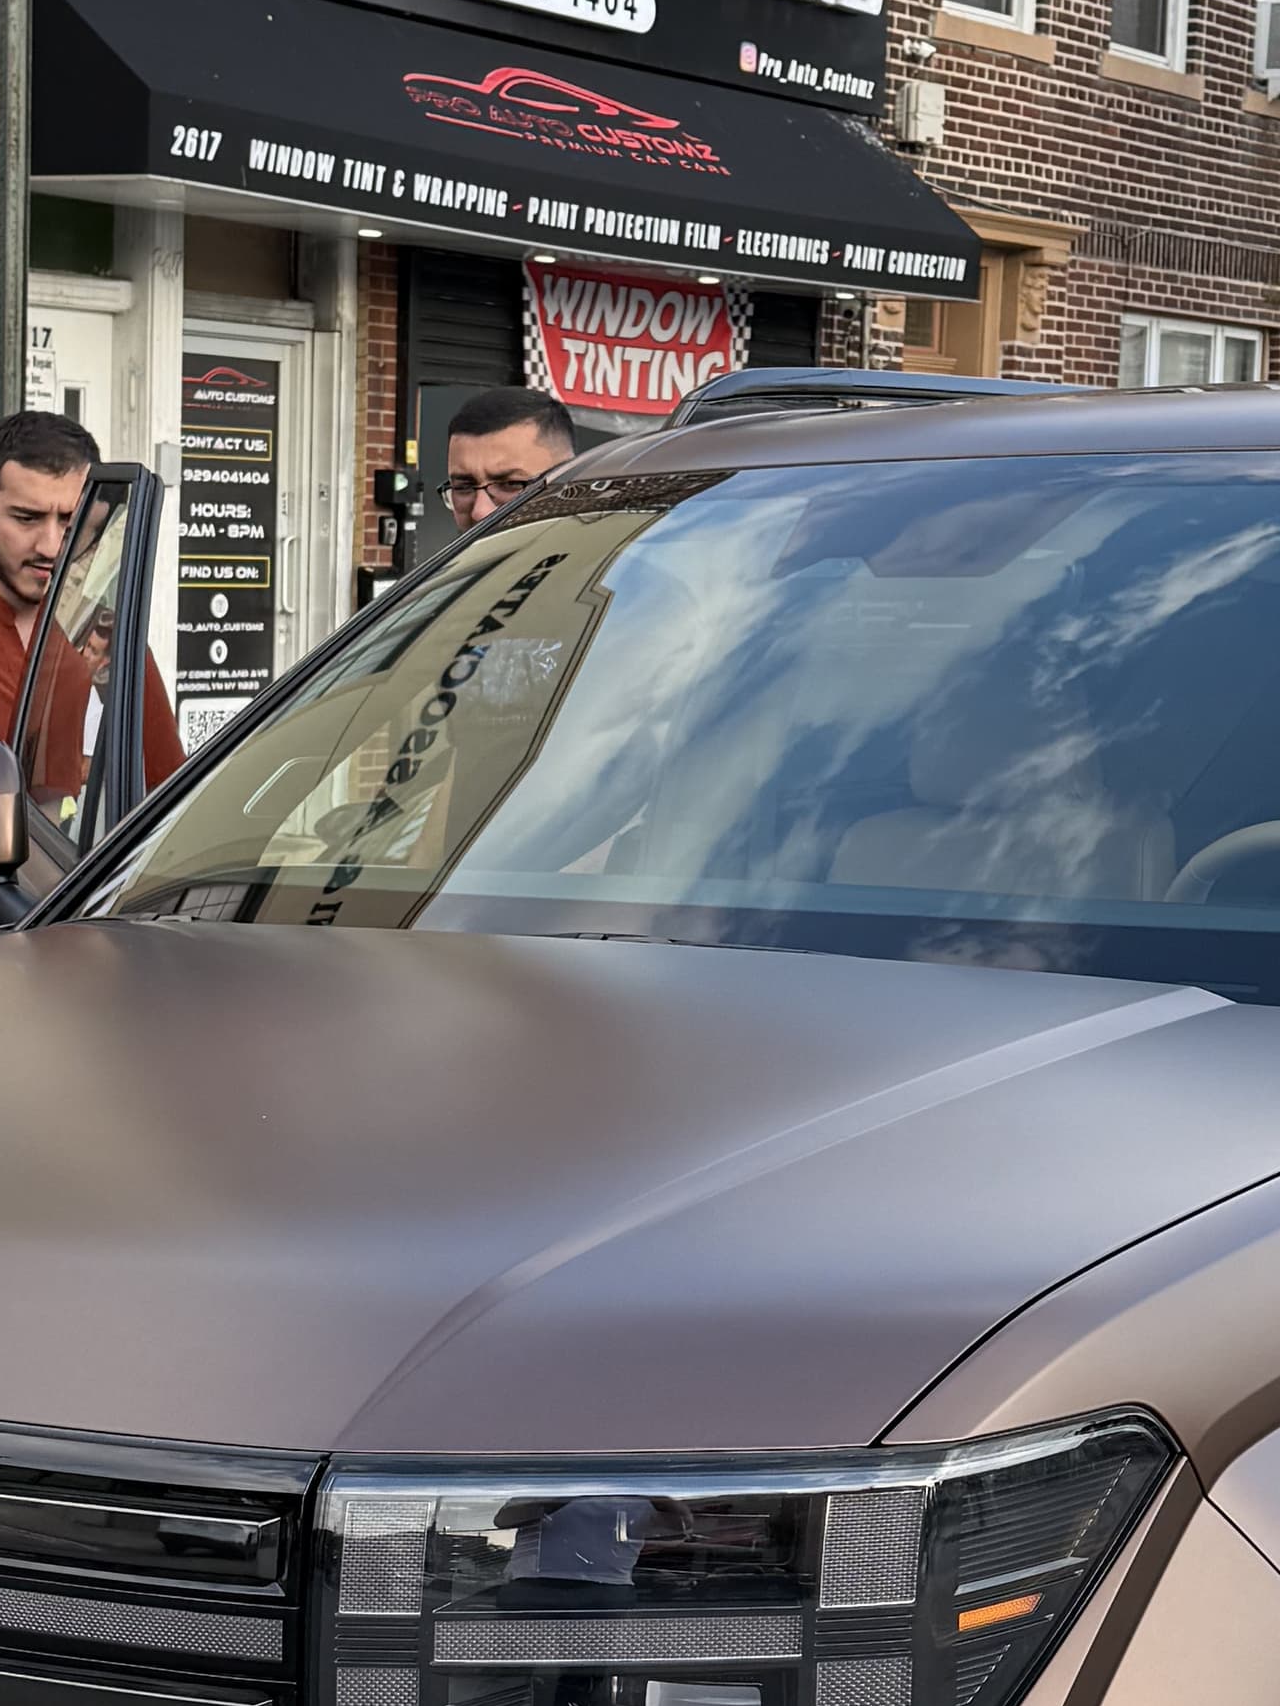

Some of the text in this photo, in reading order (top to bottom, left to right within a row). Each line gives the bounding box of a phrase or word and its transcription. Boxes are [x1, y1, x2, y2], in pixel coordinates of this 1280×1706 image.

[757, 52, 875, 100] Pro_Auto_Customz
[577, 123, 721, 162] CUSTOMZ
[170, 125, 222, 162] 2617
[249, 139, 335, 184] WINDOW
[342, 158, 387, 194] TINT
[393, 169, 406, 198] &
[413, 172, 509, 218] WRAPPING
[527, 196, 580, 232] PAINT
[583, 207, 680, 247] PROTECTION
[684, 221, 722, 251] FILM
[736, 229, 830, 266] ELECTRONICS
[842, 243, 886, 274] PAINT
[887, 250, 968, 283] CORRECTION
[542, 273, 724, 346] WINDOW
[560, 337, 726, 401] TINTING
[193, 389, 224, 401] AUTO
[180, 434, 268, 452] CONTACT US:
[183, 468, 270, 484] 9294041404
[190, 502, 251, 519] HOURS:
[227, 524, 265, 539] 8PM
[180, 564, 259, 580] FIND US ON:
